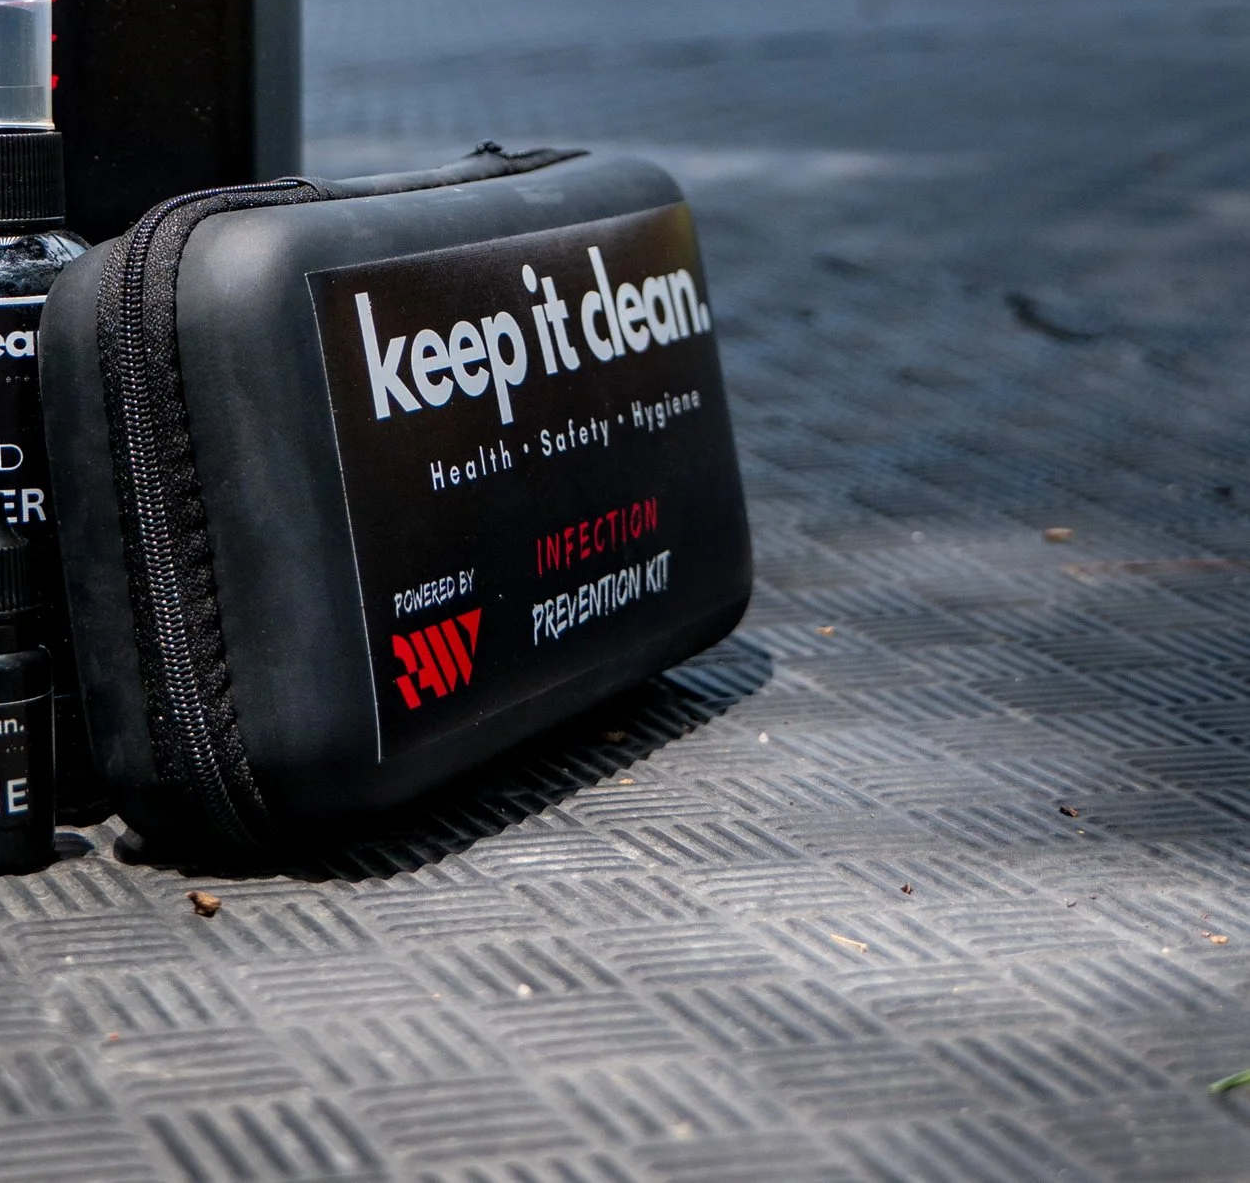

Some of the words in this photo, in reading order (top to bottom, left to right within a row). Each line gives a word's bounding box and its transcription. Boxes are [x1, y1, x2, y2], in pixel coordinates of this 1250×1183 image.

[355, 292, 528, 424] keep
[522, 264, 581, 375] it
[581, 246, 711, 362] clean.
[431, 440, 512, 491] Health
[540, 418, 610, 456] Safety
[631, 390, 700, 432] Hygiene
[537, 498, 658, 578] INFECTION
[394, 575, 456, 618] POWERED
[458, 567, 475, 595] BY
[532, 563, 641, 646] PREVENTION
[646, 549, 671, 593] KIT
